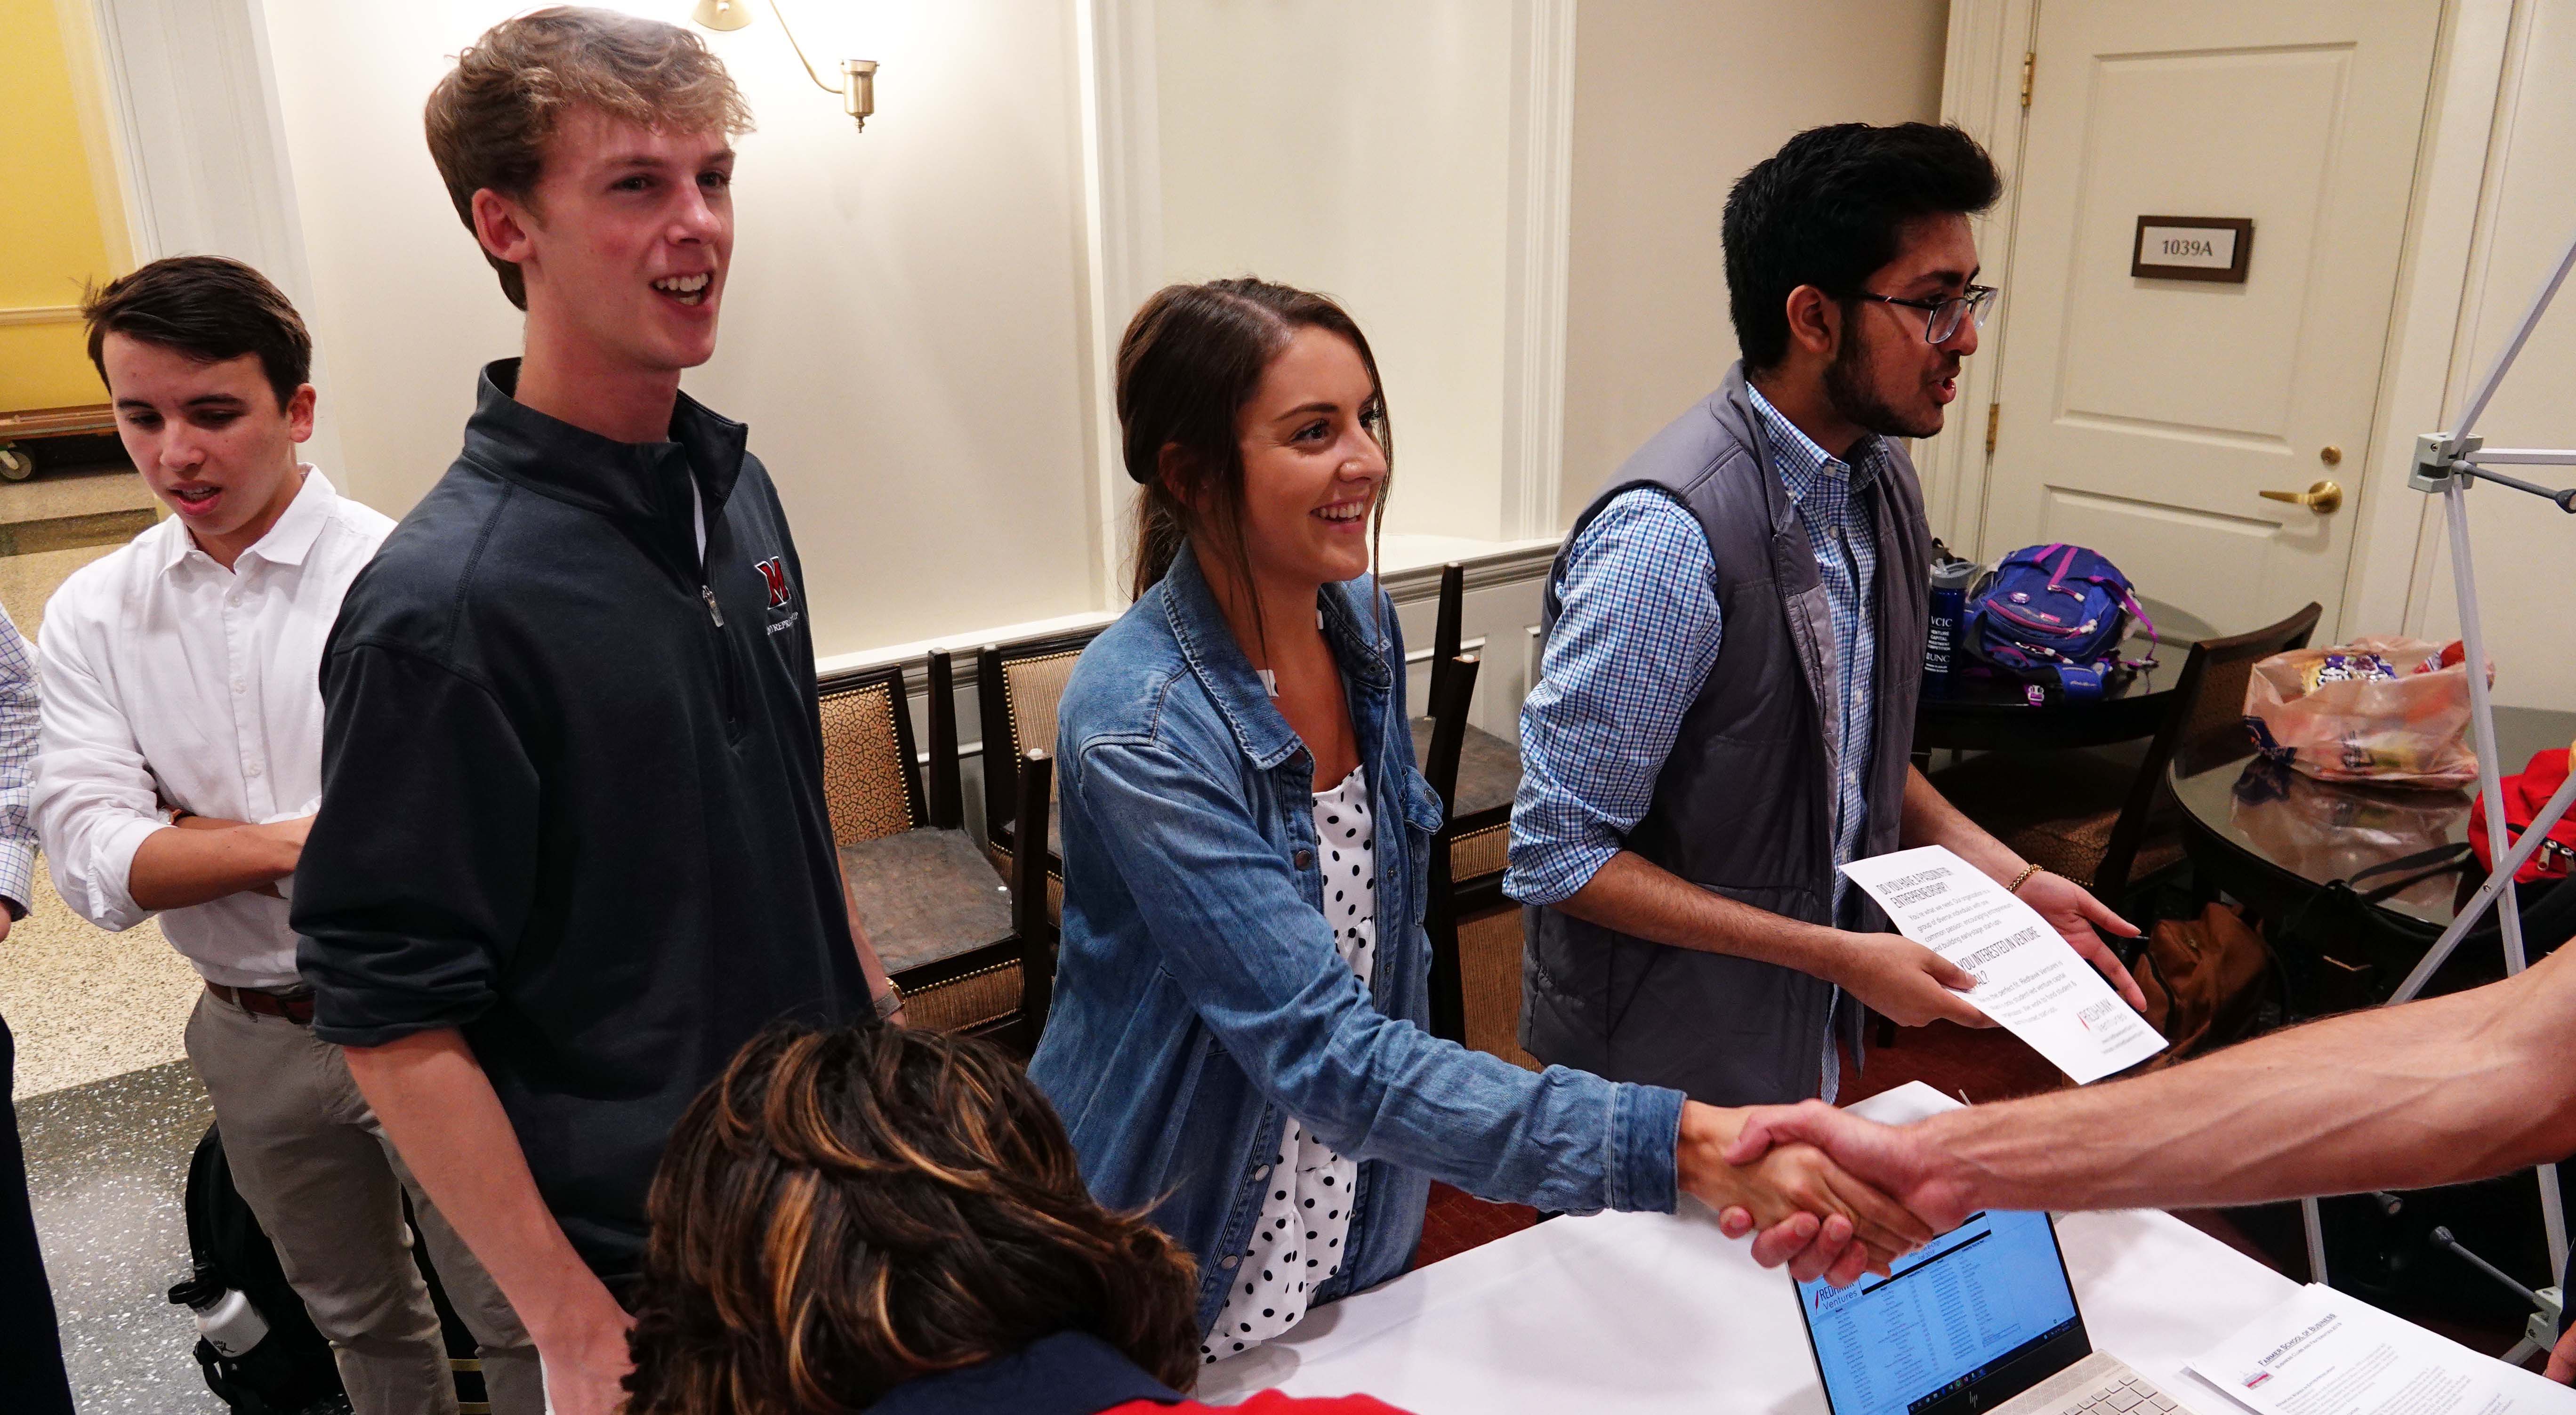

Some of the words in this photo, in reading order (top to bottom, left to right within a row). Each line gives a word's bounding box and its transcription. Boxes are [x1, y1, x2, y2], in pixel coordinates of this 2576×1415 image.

[2162, 240, 2213, 257] 1039A
[755, 556, 791, 610] M
[1931, 615, 1953, 627] VCIC
[1930, 653, 1950, 662] UNC
[1876, 884, 1892, 895] DO
[1884, 881, 1903, 892] YOU
[1895, 876, 1915, 889] HAVE
[1890, 882, 1951, 908] ENTREPRENEURSHIP?
[1924, 929, 1947, 942] common
[1942, 934, 1963, 949] building
[1956, 956, 1976, 973] YOU
[1970, 941, 2010, 966] INTERESTED
[2004, 938, 2016, 950] IN
[2011, 926, 2042, 947] VENTURE
[1823, 1290, 1858, 1310] Ventures
[2258, 1348, 2283, 1366] FARMER
[2280, 1335, 2304, 1350] SCHOOL
[2308, 1313, 2336, 1333] BUSINESS
